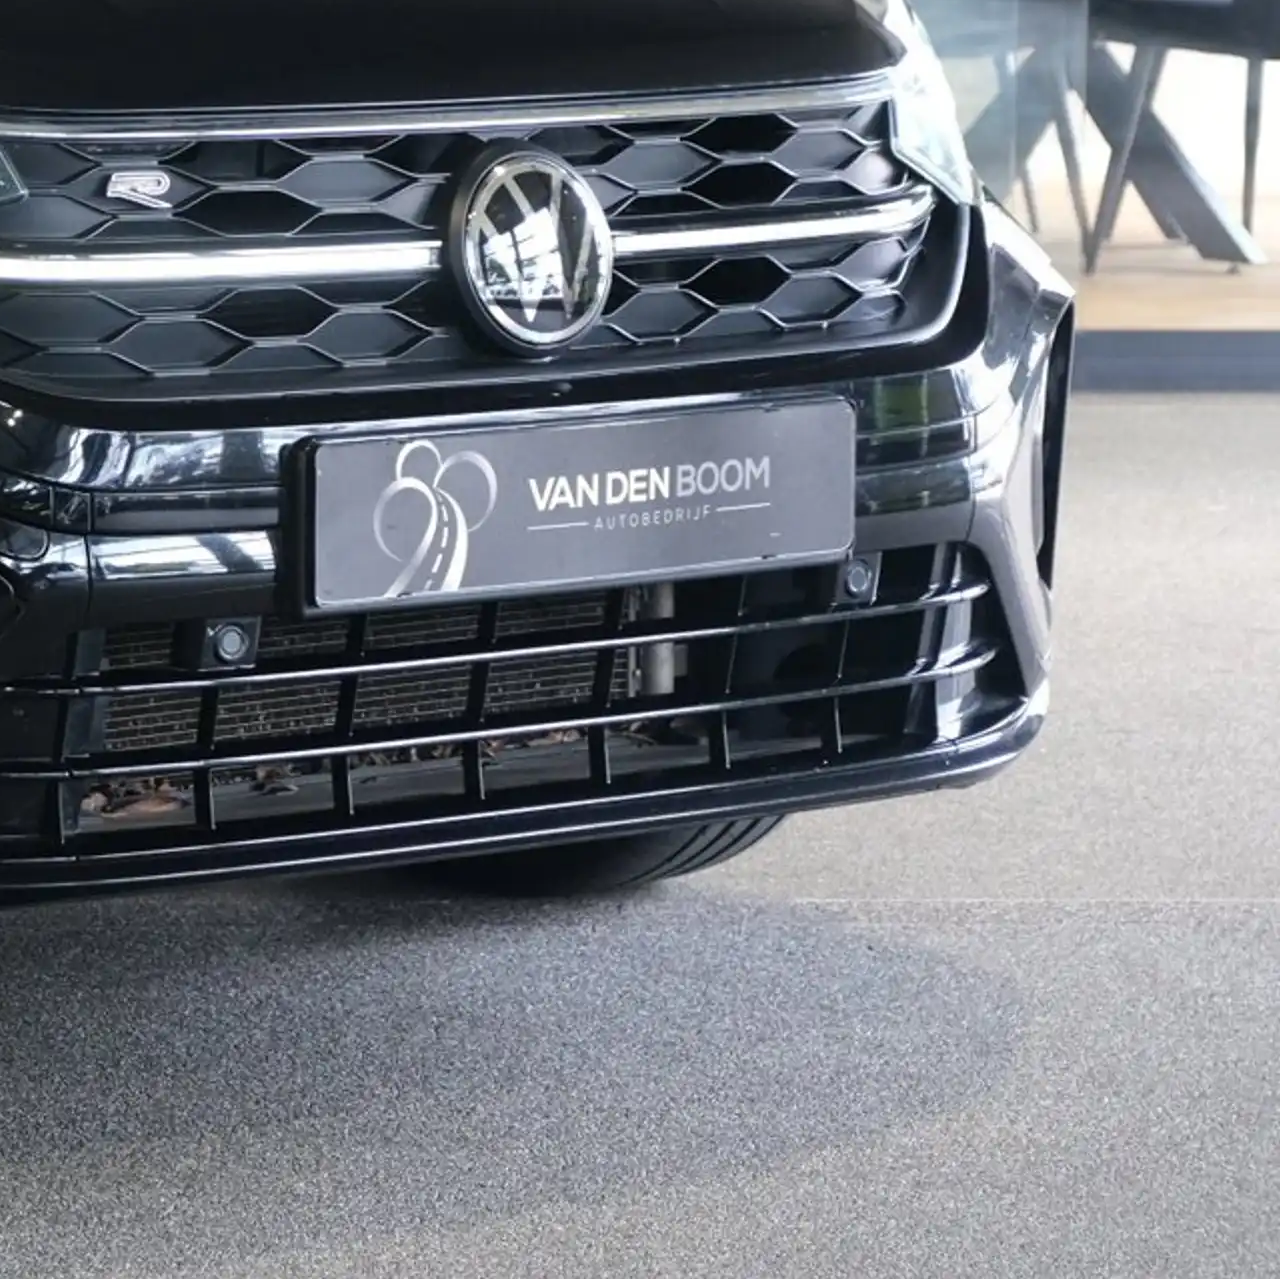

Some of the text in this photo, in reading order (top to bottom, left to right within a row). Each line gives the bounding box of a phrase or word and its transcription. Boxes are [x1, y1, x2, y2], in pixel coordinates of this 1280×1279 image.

[528, 455, 771, 512] VAN DEN BOOM
[594, 504, 712, 532] AUTOBEDRIJF
